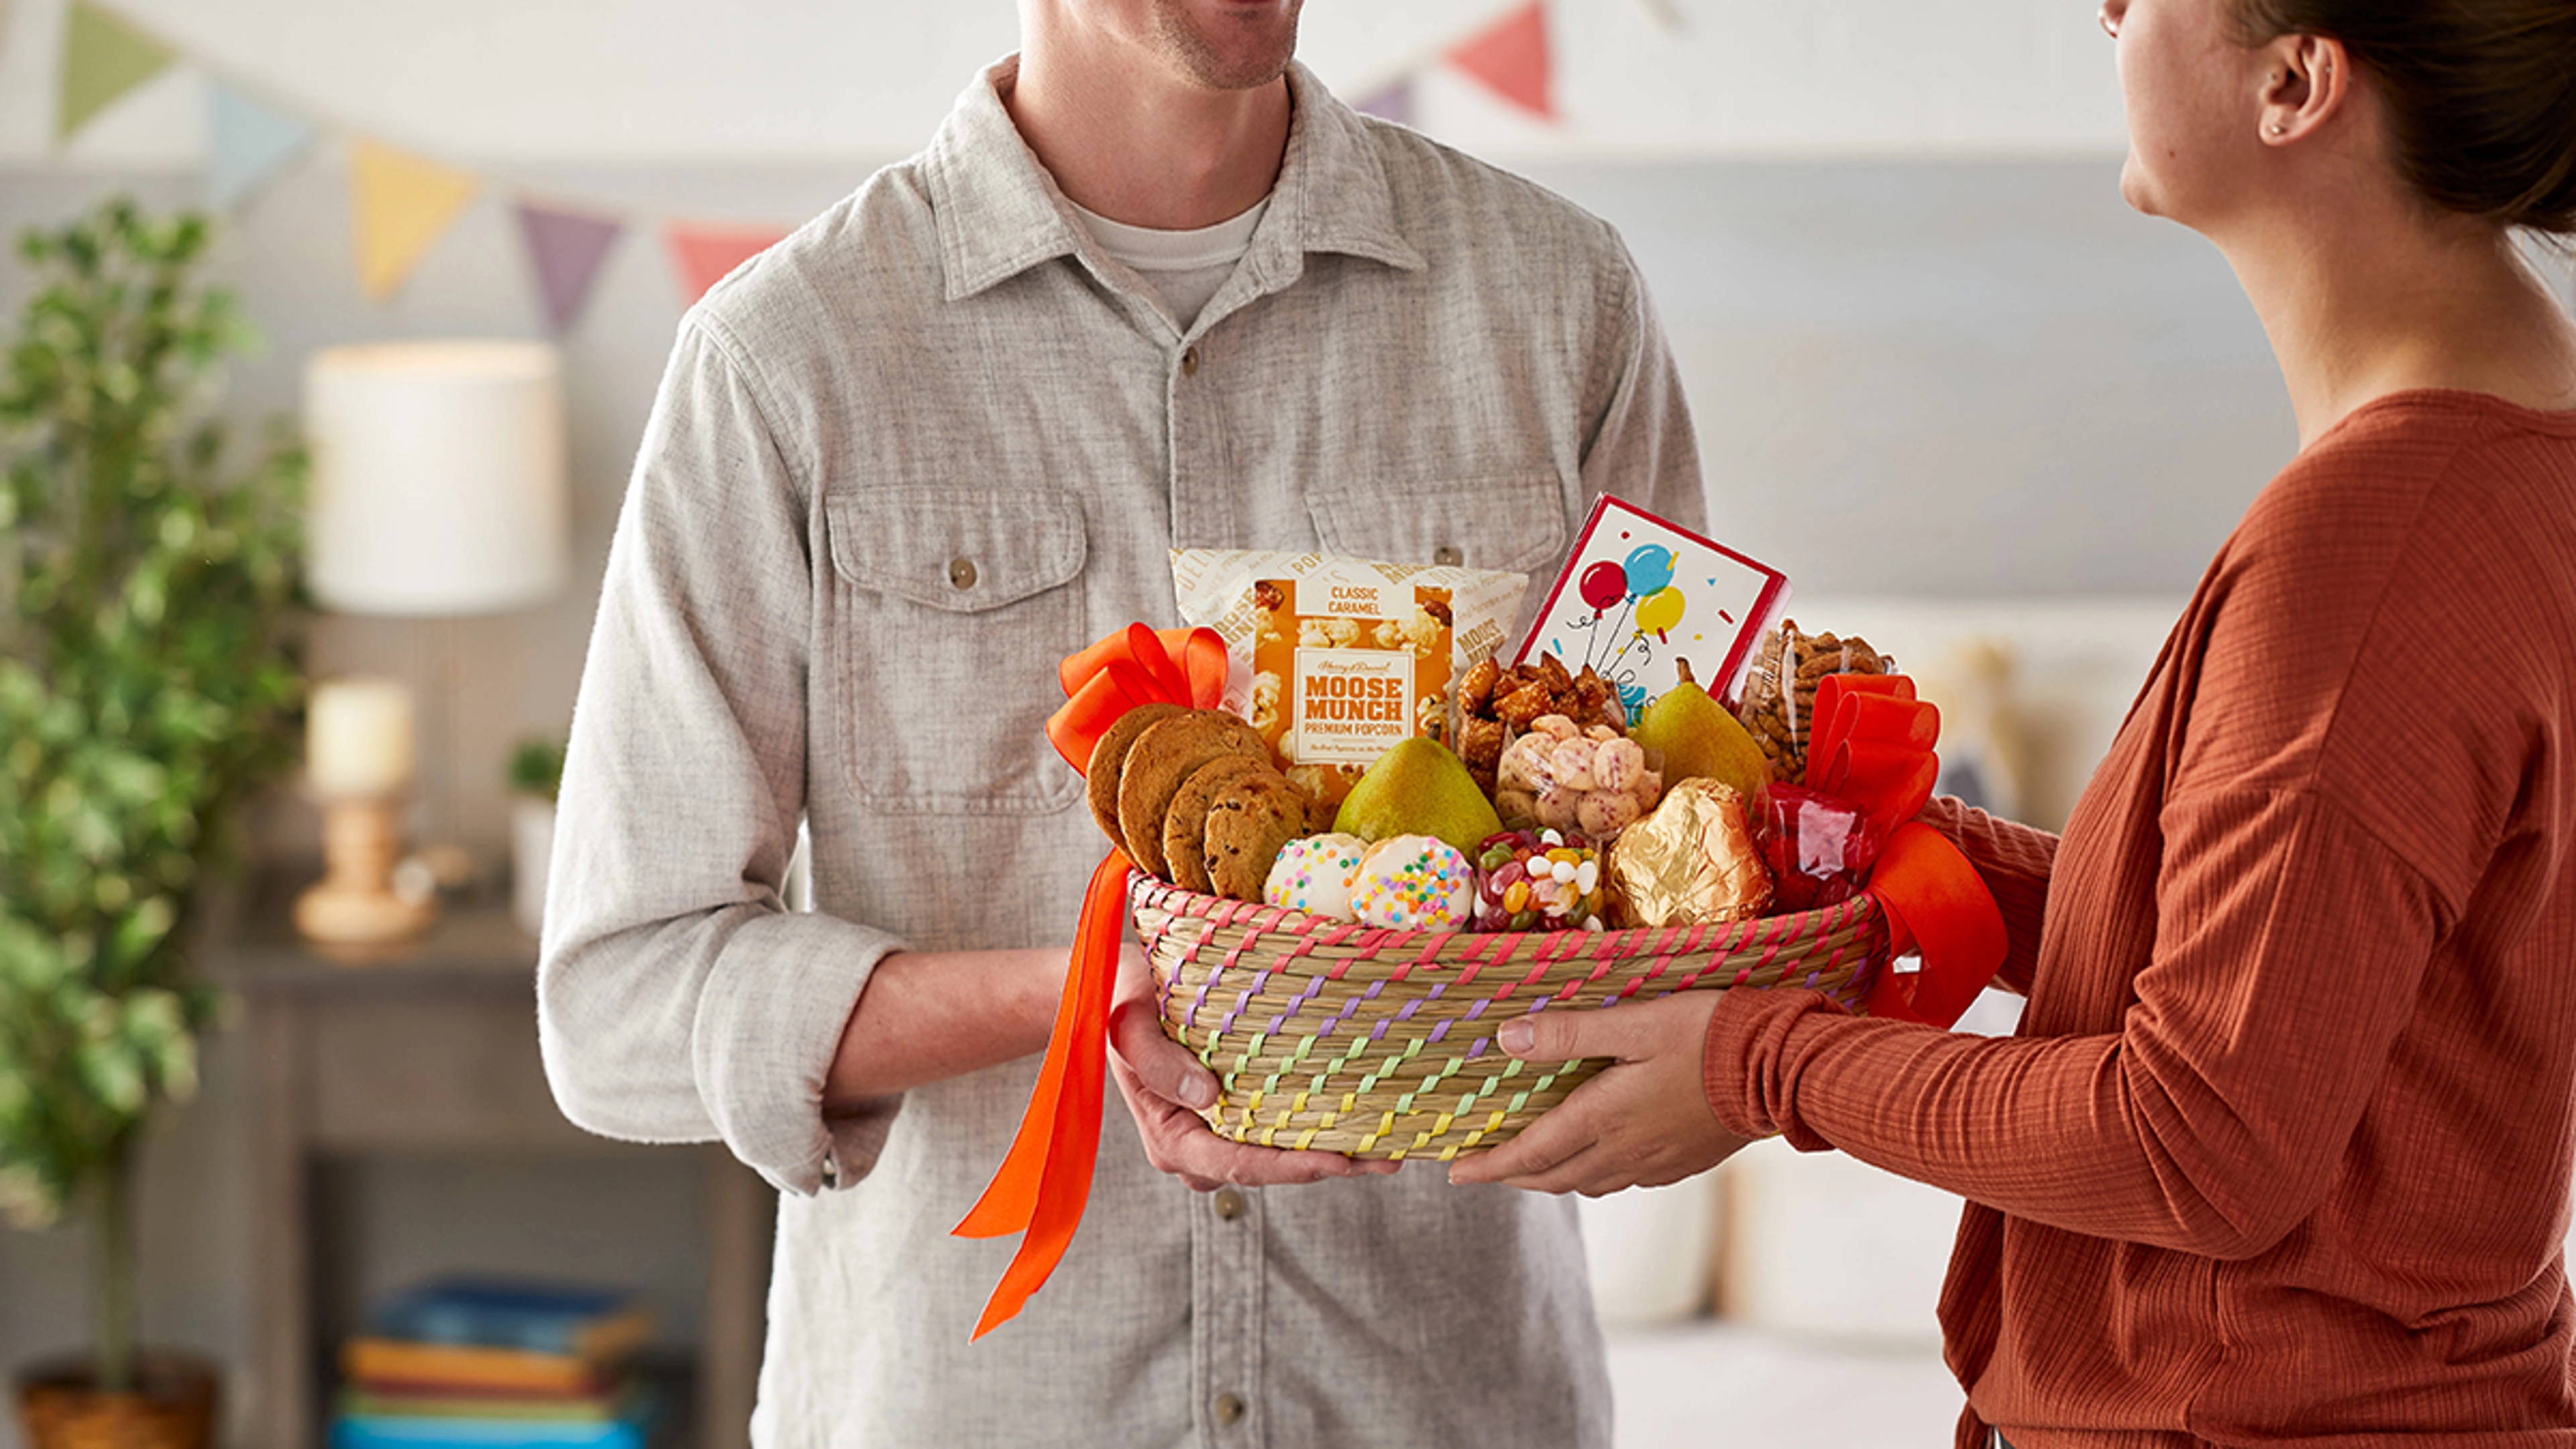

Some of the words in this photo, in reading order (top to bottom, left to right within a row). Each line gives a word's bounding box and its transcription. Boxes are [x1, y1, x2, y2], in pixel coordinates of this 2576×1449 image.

[1331, 586, 1378, 600] CLASSIC
[1328, 601, 1381, 615] CARAMEL
[1305, 676, 1403, 698] MOOSE
[1305, 700, 1403, 721] MUNCH
[1305, 722, 1352, 735] PREMIUM
[1354, 723, 1403, 735] POPCORN
